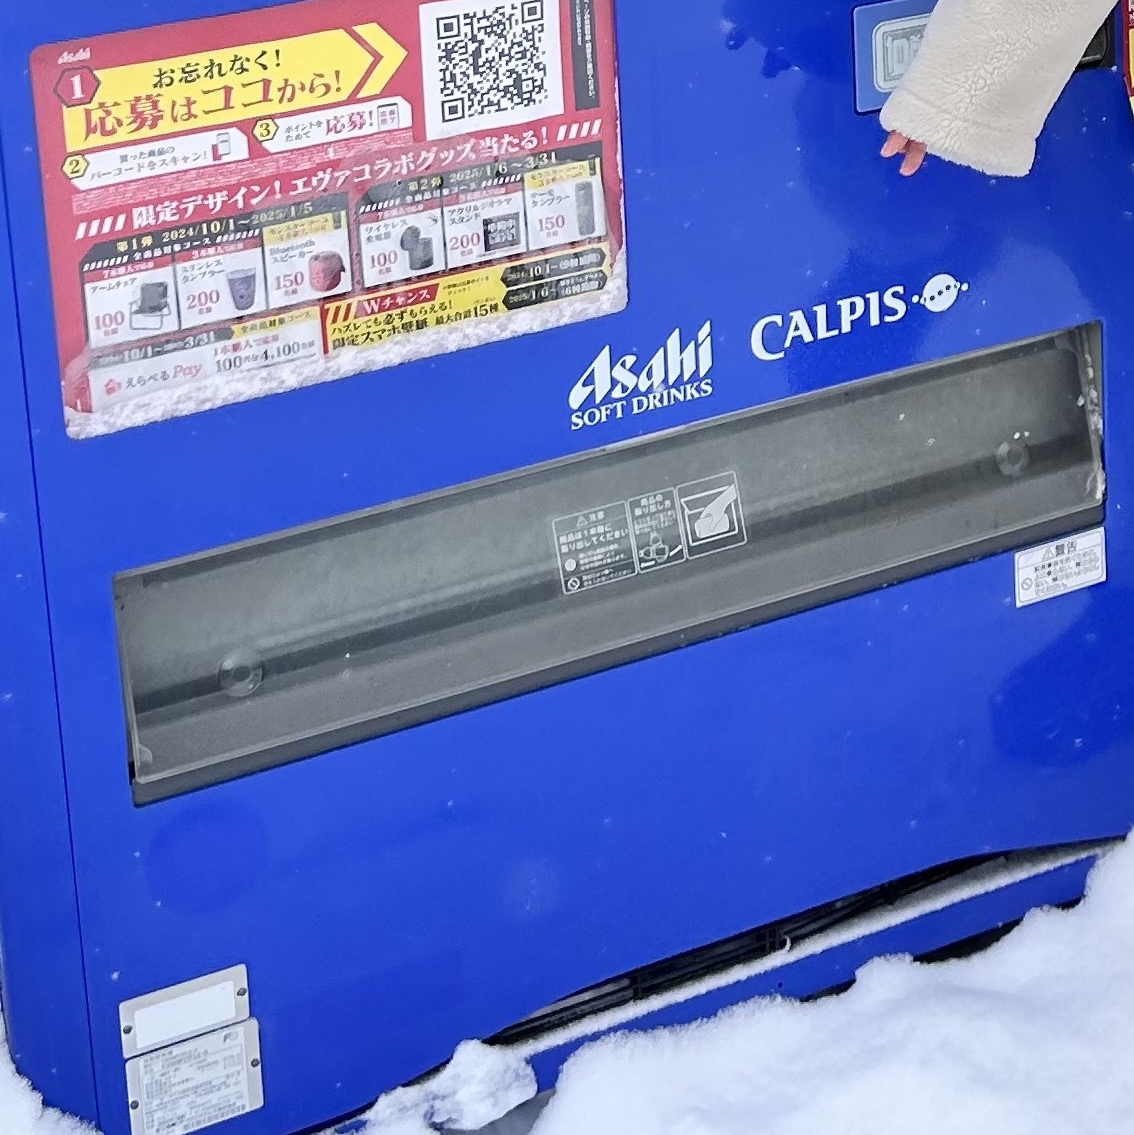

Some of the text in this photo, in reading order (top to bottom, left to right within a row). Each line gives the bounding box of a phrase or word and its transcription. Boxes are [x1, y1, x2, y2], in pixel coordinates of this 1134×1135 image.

[69, 73, 86, 100] 1
[152, 48, 282, 89] お忘れなく!
[82, 69, 343, 143] 応募はココから!
[259, 122, 272, 139] 3
[68, 158, 81, 175] 2
[131, 127, 549, 231] 限定デザイン! エヴァコラボグッズ当たる!
[749, 285, 908, 362] CALPIS
[568, 318, 714, 411] Asahi
[569, 377, 714, 432] SOFT DRINKS
